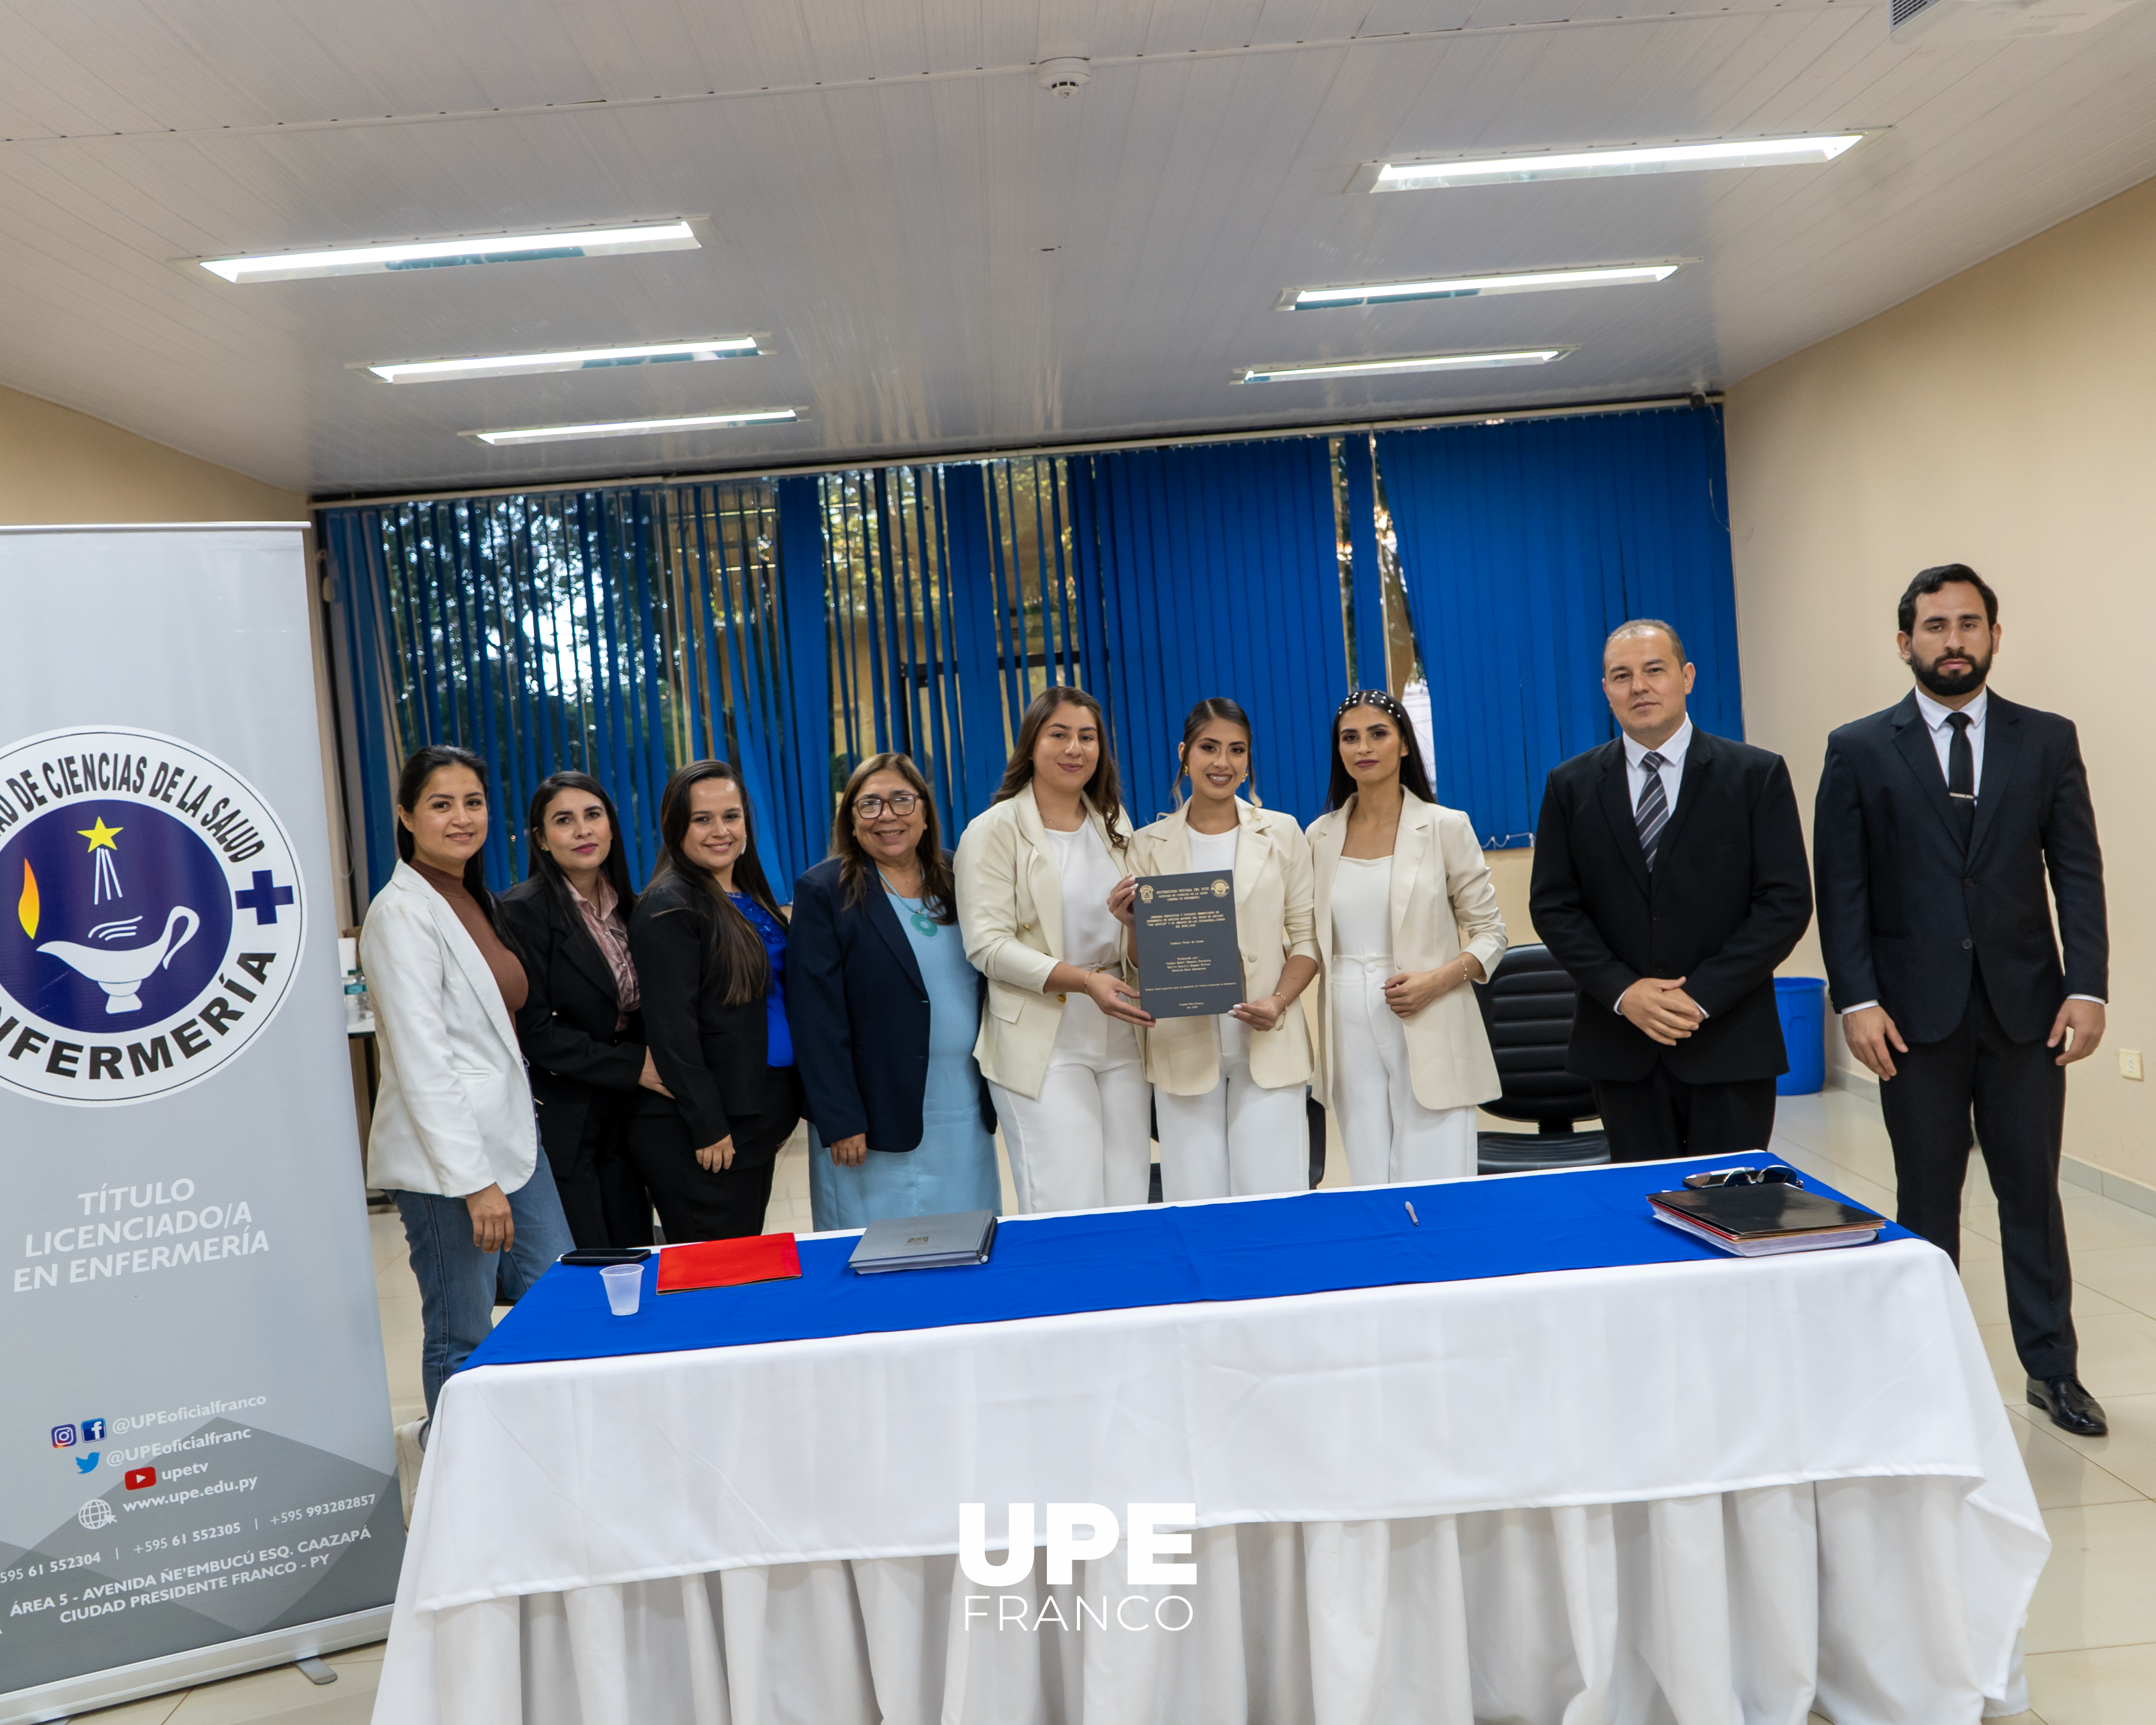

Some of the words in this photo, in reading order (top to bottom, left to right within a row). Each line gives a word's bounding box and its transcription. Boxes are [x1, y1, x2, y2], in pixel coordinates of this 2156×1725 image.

[6, 770, 48, 813] DE
[42, 753, 147, 798] CIENCIAS
[148, 762, 185, 803] DE
[176, 776, 212, 818] LA
[200, 798, 265, 863] SALUD
[78, 1177, 195, 1215] TÍTULO
[26, 1201, 252, 1258] LICENCIADO/A
[14, 1263, 58, 1293] EN
[70, 1225, 269, 1283] ENFERMERÍA
[112, 1395, 266, 1434] @UPEoficialfranco
[106, 1428, 251, 1466] @UPEoficialfranc
[162, 1462, 209, 1481] upetv
[123, 1476, 258, 1512] www.upe.edu.py
[29, 1564, 44, 1577] 61
[50, 1552, 101, 1572] 552304
[133, 1538, 168, 1554] +595
[172, 1534, 187, 1546] 61
[192, 1522, 241, 1542] 552305
[270, 1509, 303, 1525] +595
[306, 1493, 376, 1517] 993282857
[10, 1600, 55, 1617] ÁREA
[59, 1593, 68, 1606] 5
[82, 1575, 157, 1601] AVENIDA
[259, 1546, 294, 1562] ESQ.
[297, 1525, 371, 1553] CAAZAPÁ
[60, 1599, 126, 1623] CIUDAD
[130, 1577, 228, 1608] PRESIDENTE
[232, 1562, 297, 1585] FRANCO
[310, 1554, 330, 1568] PY
